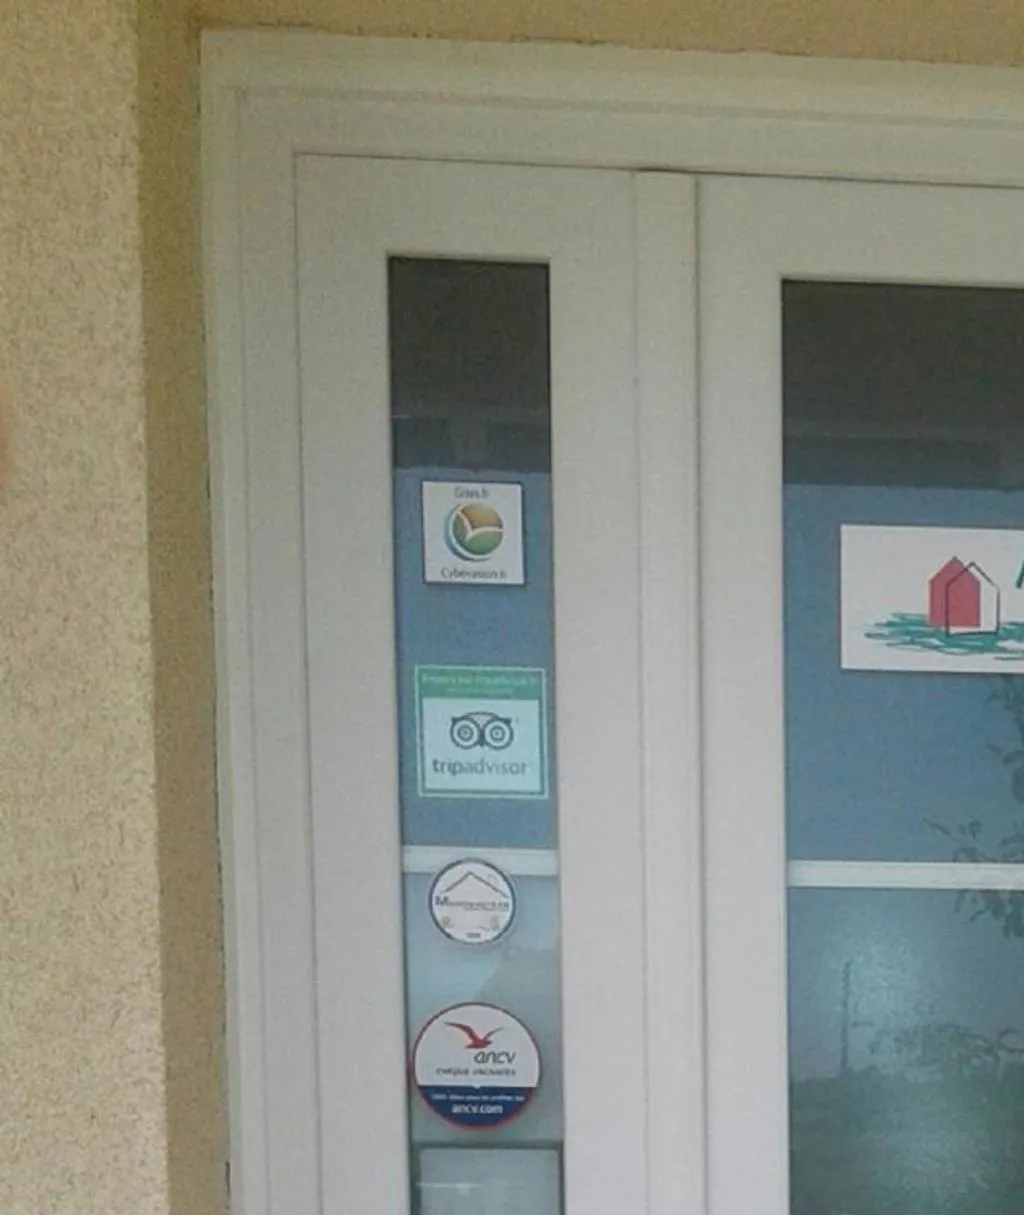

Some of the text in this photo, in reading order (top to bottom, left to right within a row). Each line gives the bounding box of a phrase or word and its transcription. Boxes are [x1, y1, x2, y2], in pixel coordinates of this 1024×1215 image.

[432, 758, 529, 776] tripadvisor
[473, 1051, 517, 1065] ancv
[451, 1103, 504, 1115] ancv.com
